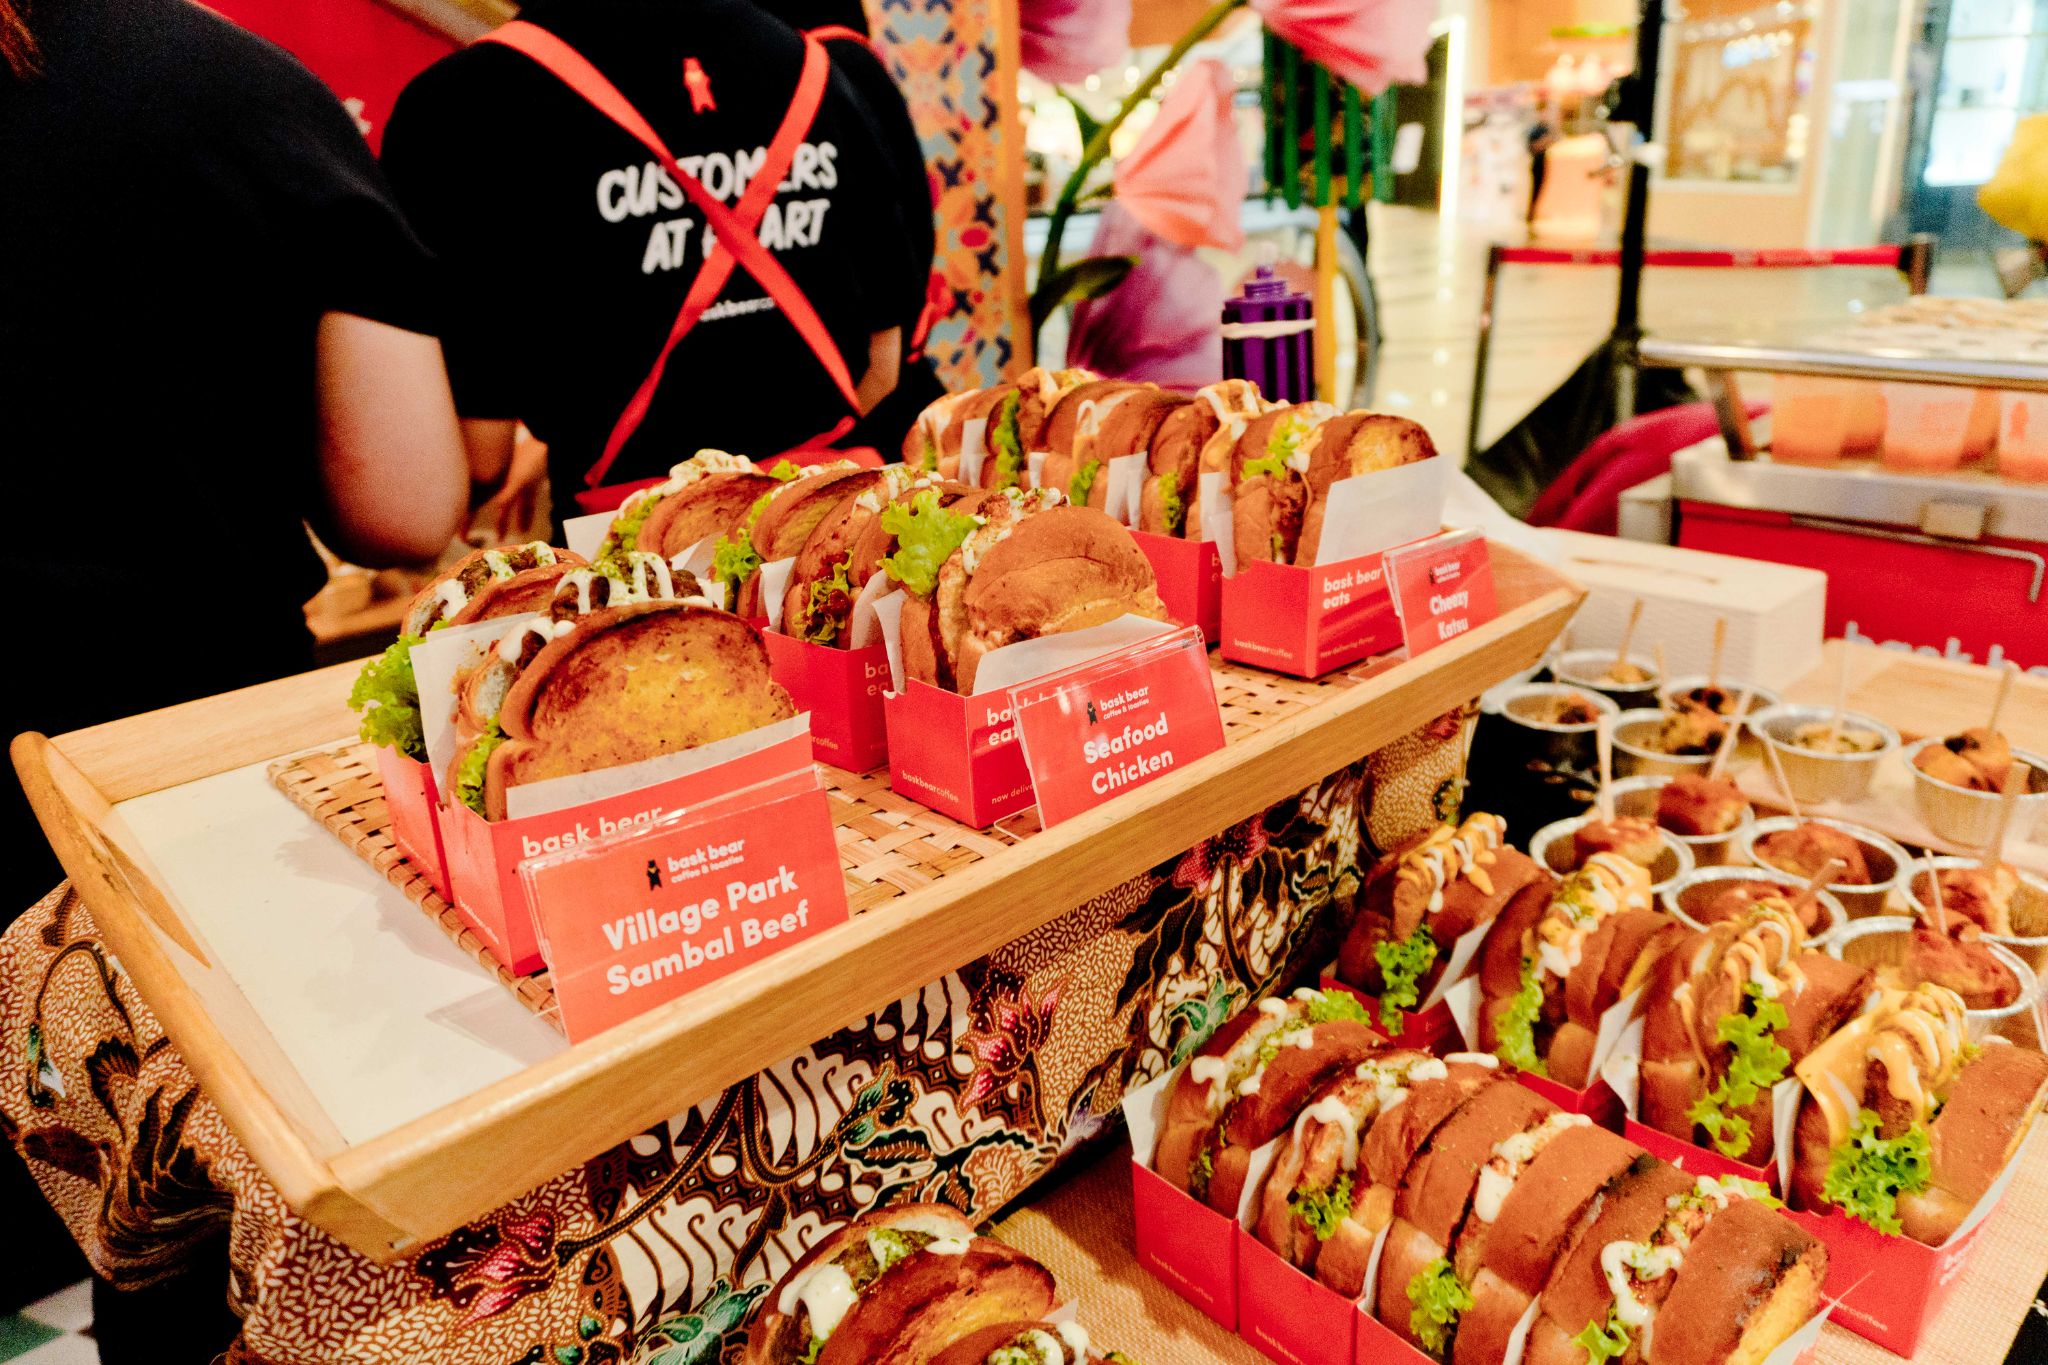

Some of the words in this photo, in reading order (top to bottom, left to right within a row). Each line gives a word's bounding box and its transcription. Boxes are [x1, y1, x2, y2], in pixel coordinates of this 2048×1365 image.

[597, 141, 837, 223] CUSTOMRS
[641, 217, 695, 274] AT
[1324, 572, 1353, 593] bask
[1356, 567, 1383, 585] bear
[1323, 591, 1351, 609] eats
[1100, 692, 1127, 711] bask
[1125, 686, 1149, 702] bear
[1083, 712, 1169, 764] Seafood
[902, 770, 960, 803] baskbearcoffee
[1091, 750, 1174, 795] Chicken
[991, 793, 1009, 805] now
[522, 822, 592, 859] bask
[667, 848, 708, 873] bask
[707, 839, 745, 860] bear
[601, 898, 720, 951] Village
[726, 865, 799, 912] Park
[606, 926, 735, 995] Sambal
[741, 899, 809, 948] Beef
